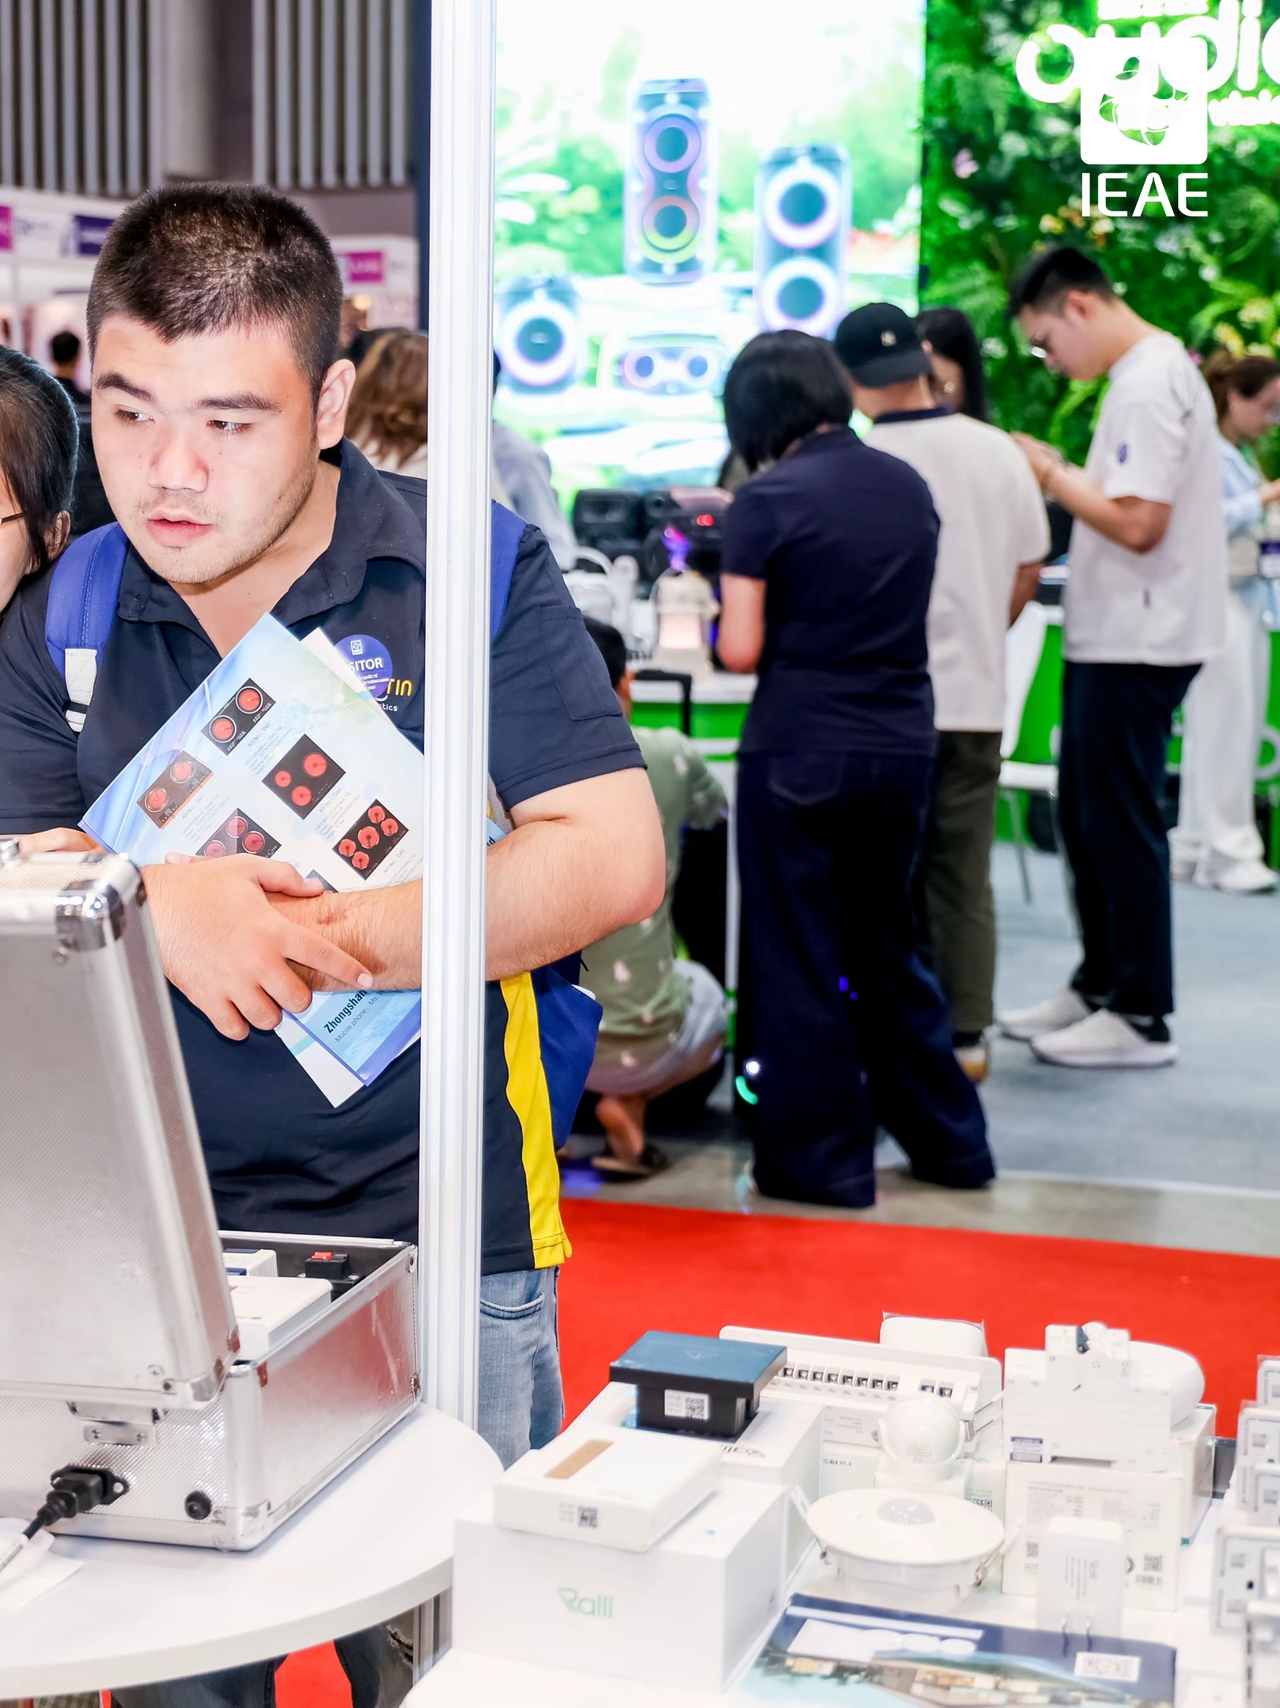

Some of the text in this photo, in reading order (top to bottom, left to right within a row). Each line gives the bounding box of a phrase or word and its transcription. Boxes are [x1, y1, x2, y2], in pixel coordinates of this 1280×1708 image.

[348, 657, 384, 672] SITOR
[380, 703, 398, 712] tics
[324, 989, 367, 1034] Zhongshan
[334, 1021, 353, 1043] Mobile
